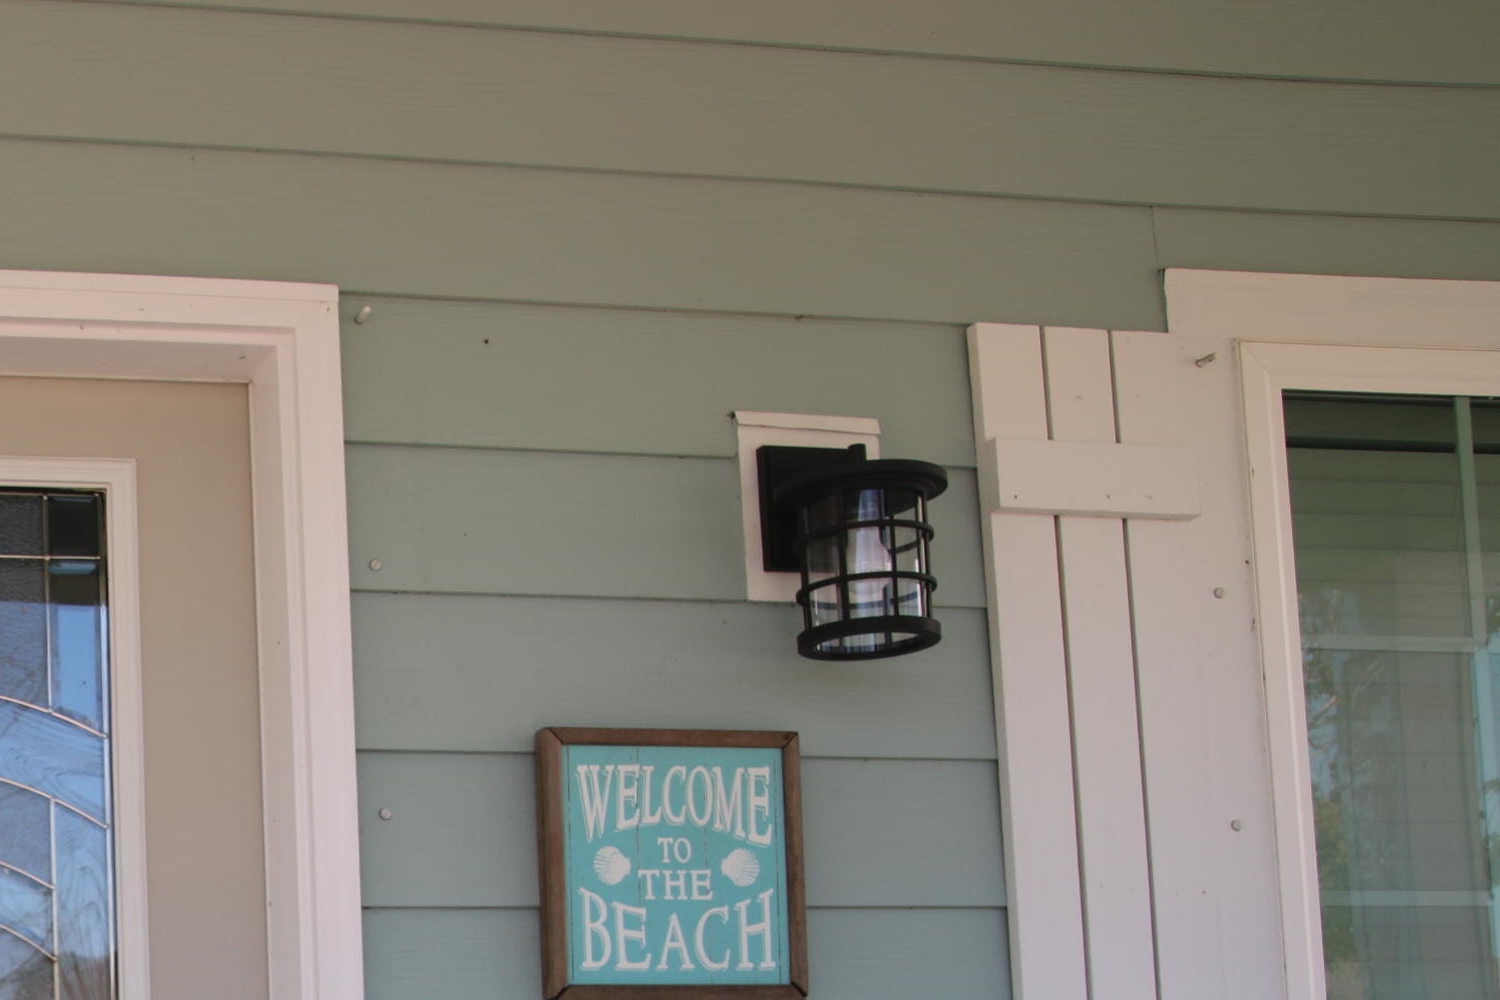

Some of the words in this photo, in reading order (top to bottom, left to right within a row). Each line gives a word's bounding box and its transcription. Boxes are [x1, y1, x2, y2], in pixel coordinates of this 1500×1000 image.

[576, 764, 773, 846] WELCOME
[657, 837, 692, 863] TO
[638, 869, 714, 900] THE
[579, 887, 776, 971] BEACH
